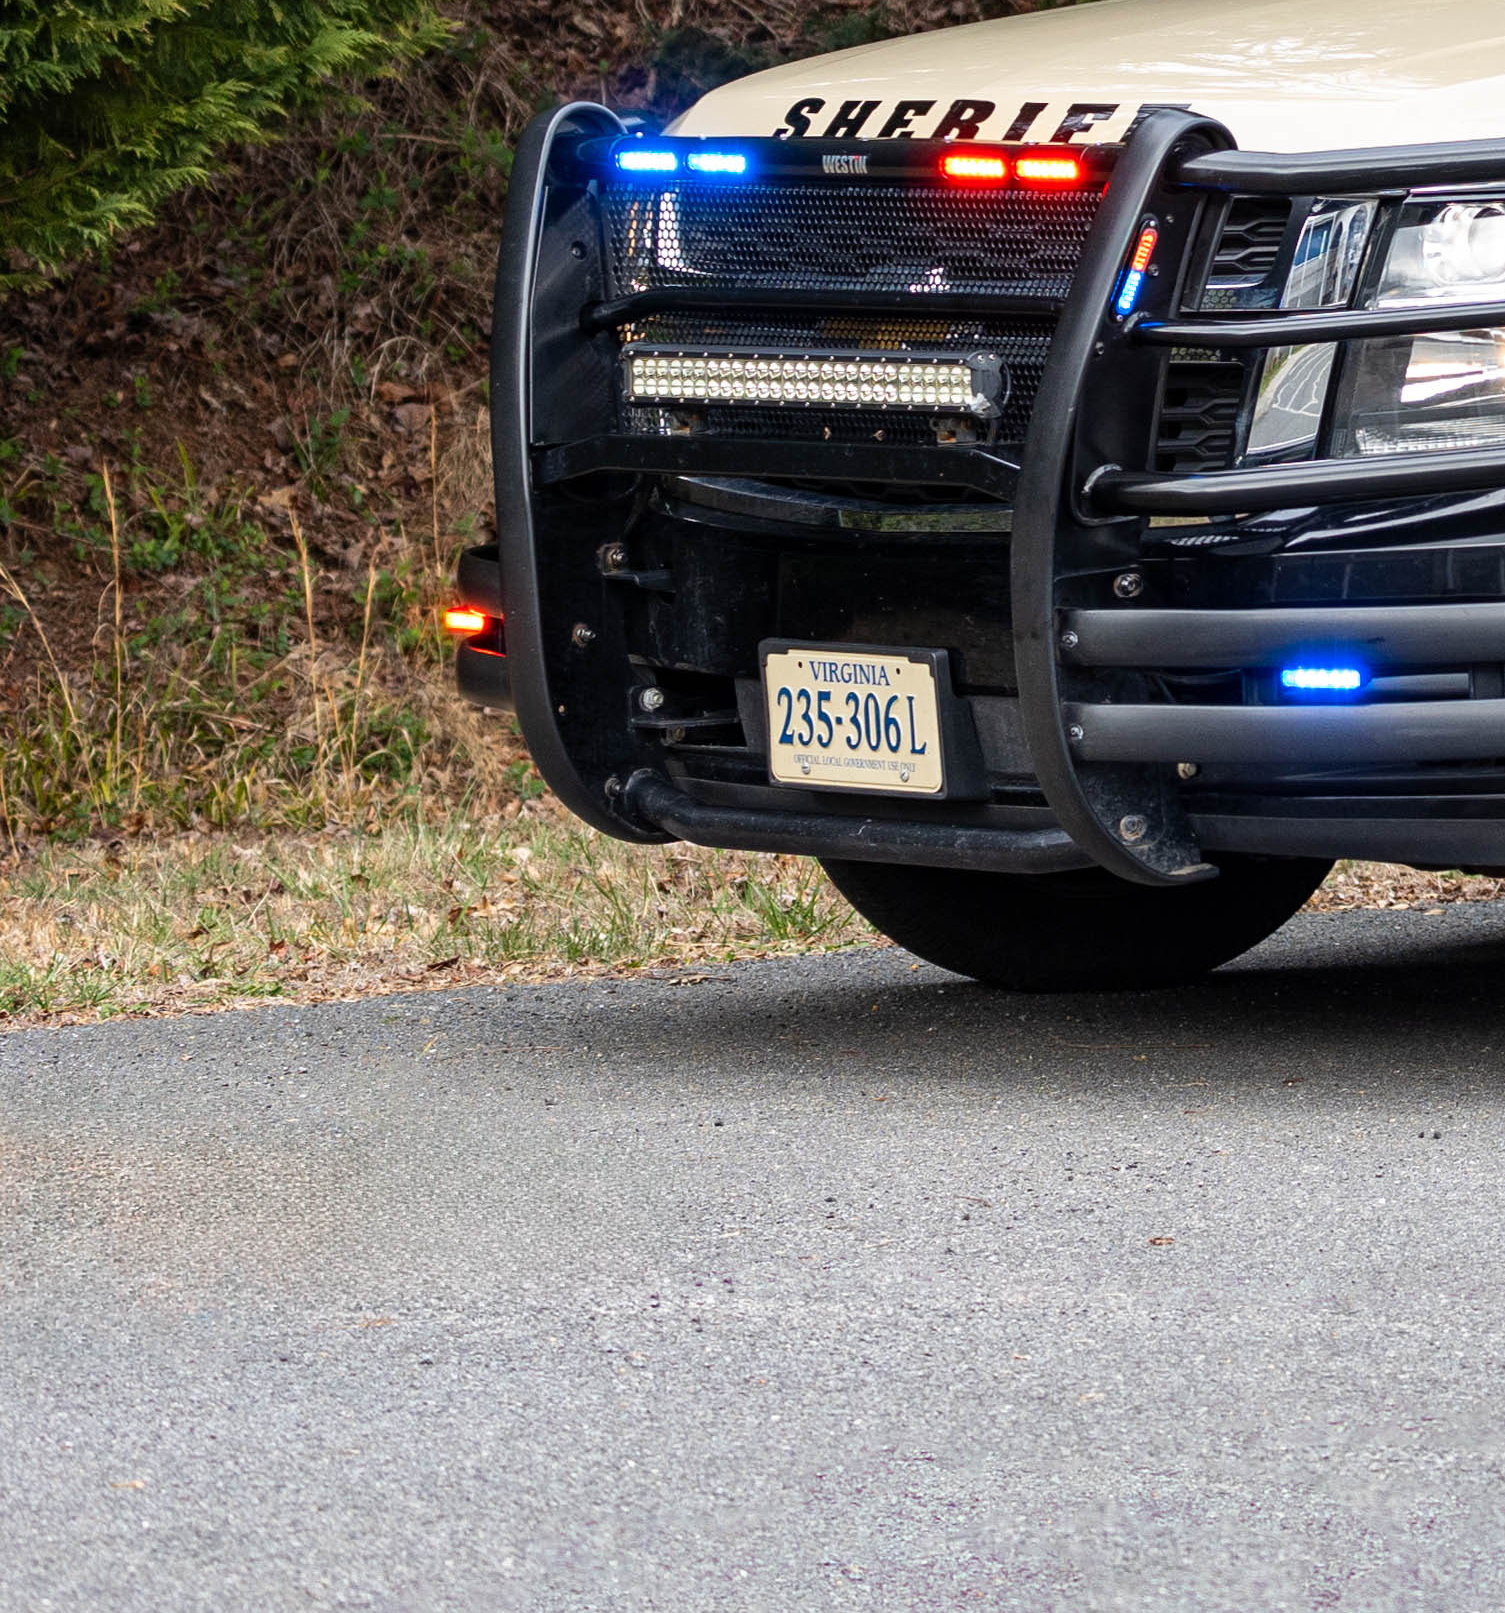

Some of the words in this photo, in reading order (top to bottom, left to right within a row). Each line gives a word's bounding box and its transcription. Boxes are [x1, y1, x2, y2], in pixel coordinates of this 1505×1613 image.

[809, 661, 891, 686] VIRGINIA
[822, 756, 842, 766] LOCAL
[843, 757, 886, 770] GOVERNMENT
[888, 760, 899, 771] USE
